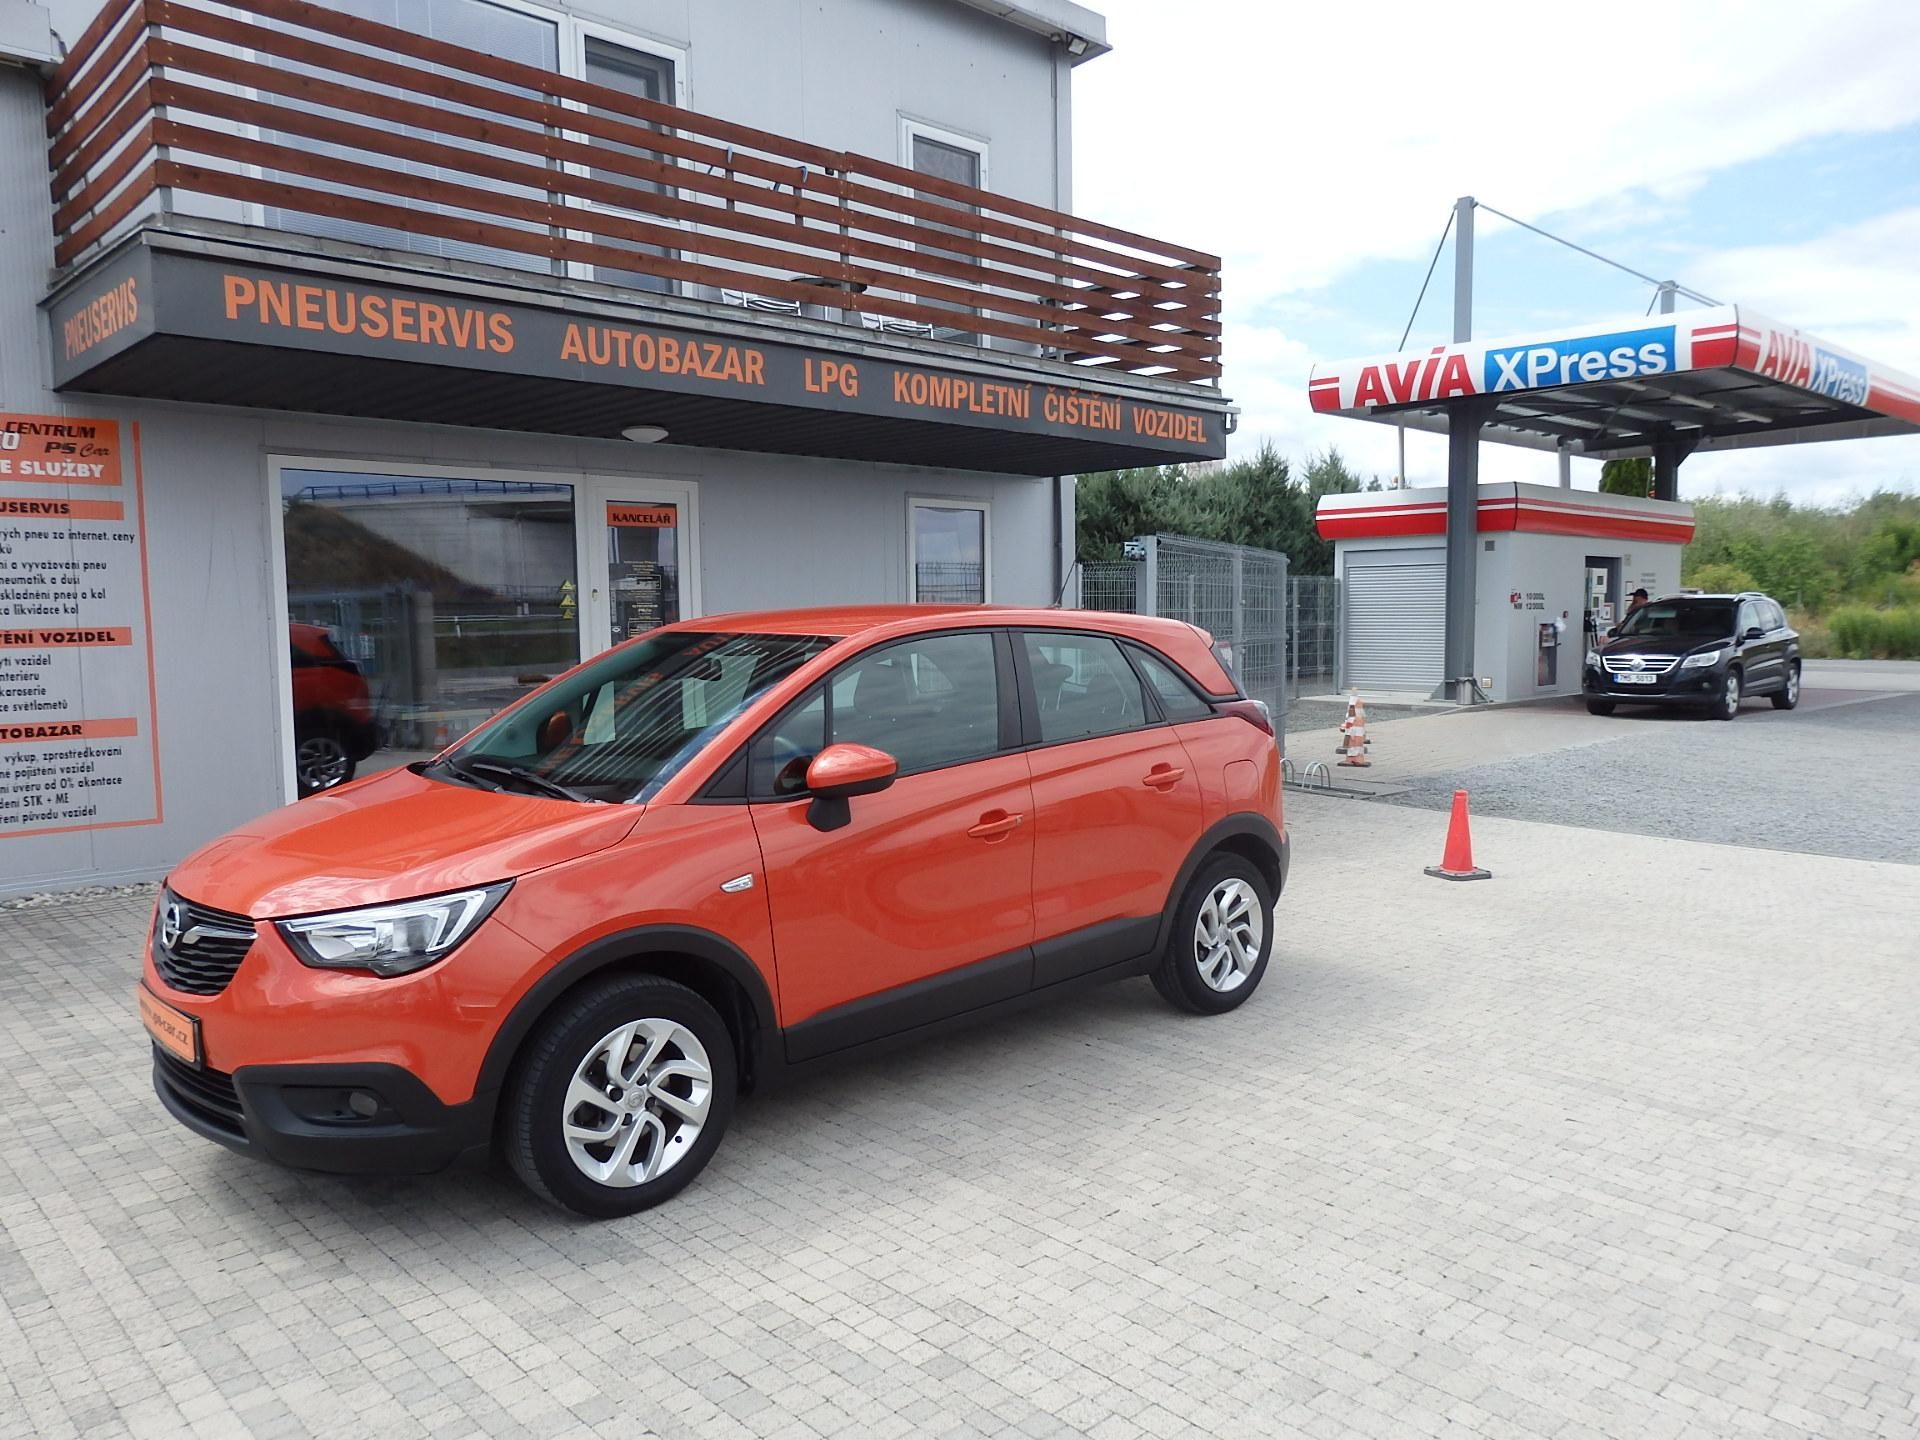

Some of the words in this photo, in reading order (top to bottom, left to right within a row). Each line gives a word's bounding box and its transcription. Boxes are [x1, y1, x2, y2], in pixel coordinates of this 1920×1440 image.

[64, 277, 137, 361] PNEUSERVIS
[223, 274, 515, 354] PNEUSERVIS
[560, 323, 766, 386] AUTOBAZAR
[804, 358, 859, 398] LPG
[893, 371, 1030, 419] KOMPLETNÍ
[1044, 387, 1121, 431] ČIŠTĚNÍ
[1133, 407, 1208, 444] VOZIDEL
[1353, 346, 1477, 408] AVIA
[1494, 342, 1668, 394] XPress
[1811, 354, 1866, 404] XPress
[5, 421, 96, 439] CENTRUM
[44, 441, 77, 455] PS
[79, 443, 111, 458] Car
[19, 458, 105, 479] SLUŽBY
[612, 512, 672, 524] KANCELÁŘ
[24, 530, 50, 541] pneu
[52, 531, 65, 540] za
[68, 528, 111, 541] internet.
[112, 531, 136, 544] ceny
[11, 561, 18, 570] a
[83, 561, 108, 572] pneu
[50, 575, 57, 585] a
[53, 590, 79, 602] pneu
[81, 591, 88, 600] a
[90, 587, 107, 600] kol
[13, 603, 61, 616] likvidace
[63, 602, 79, 615] kol
[39, 631, 116, 644] VOZIDEL
[15, 654, 51, 667] vozidel
[0, 684, 47, 697] karoserie
[12, 698, 69, 712] světlometů
[42, 746, 122, 764] zprostředkování
[60, 760, 95, 774] vozidel
[44, 778, 57, 790] od
[60, 776, 75, 789] 0%
[77, 776, 123, 788] akontace
[23, 794, 44, 808] STK
[22, 807, 59, 825] původu
[62, 803, 97, 818] vozidel
